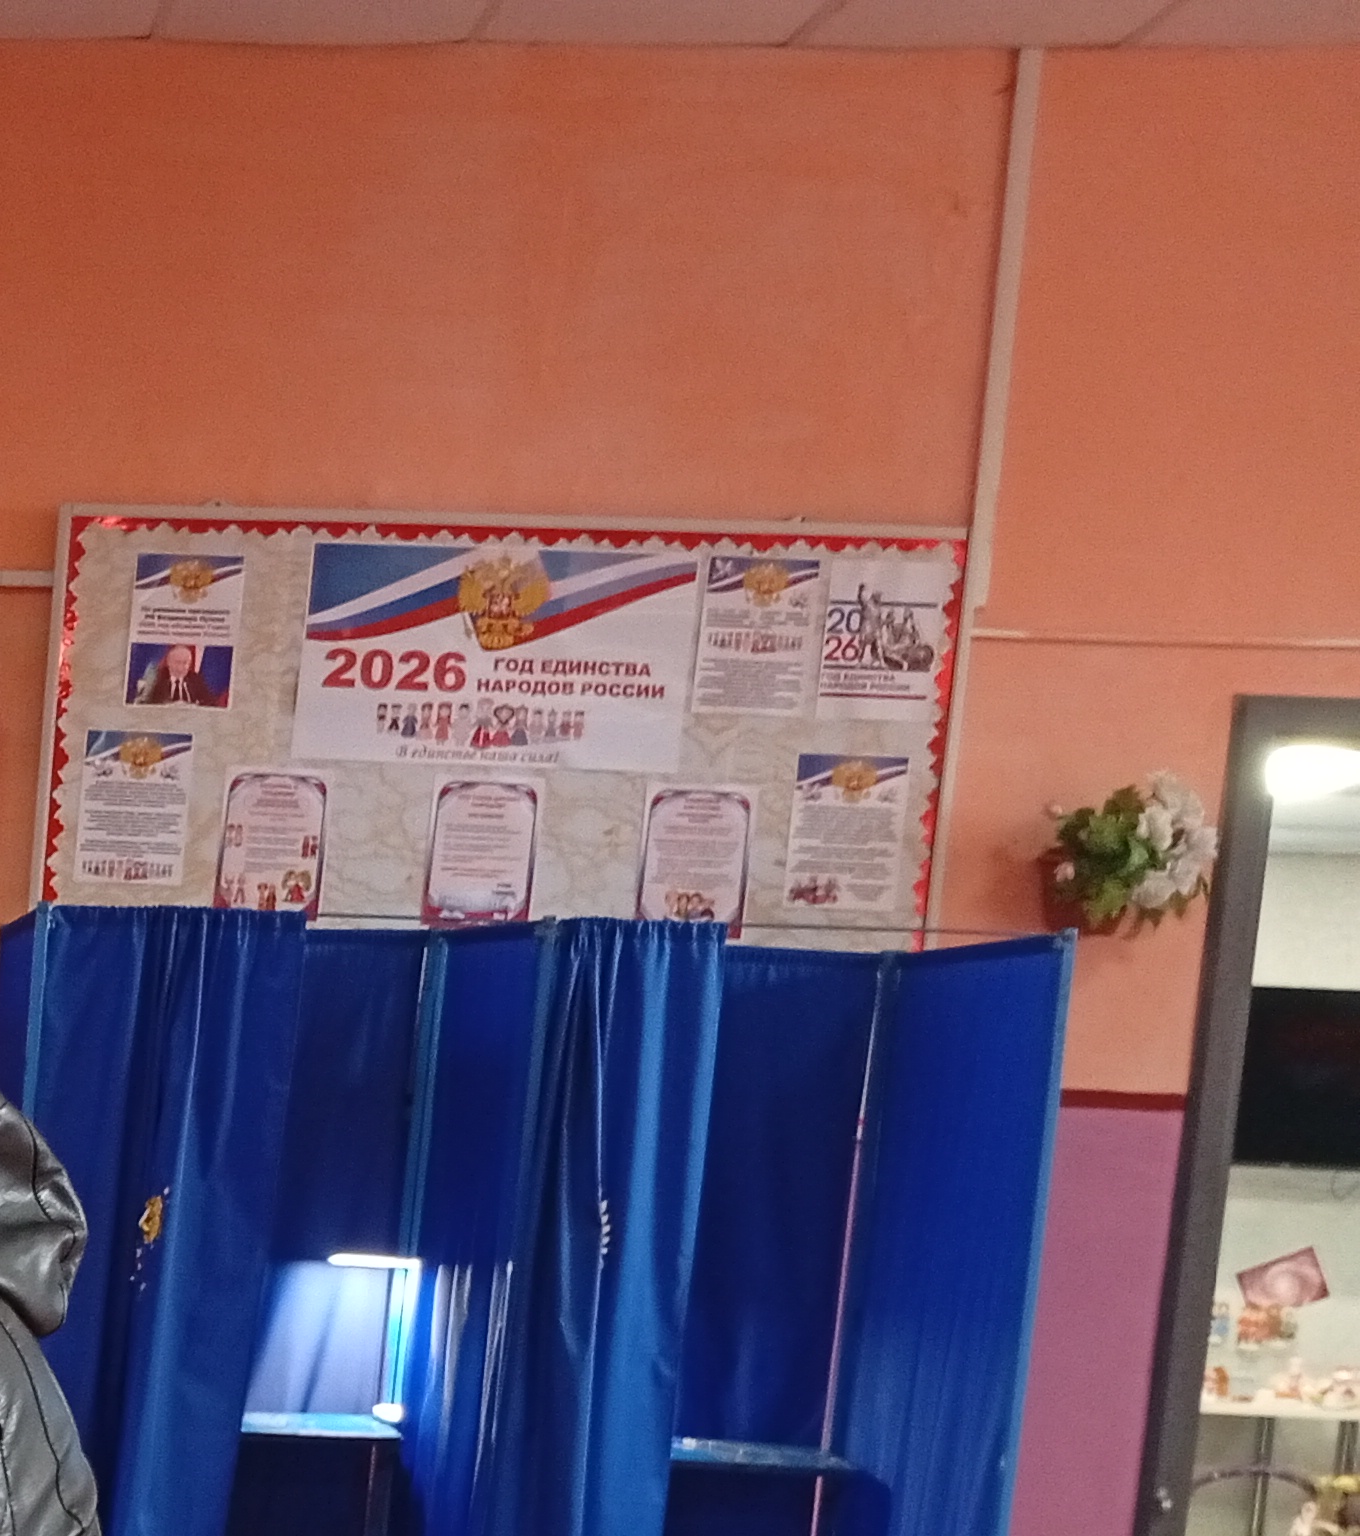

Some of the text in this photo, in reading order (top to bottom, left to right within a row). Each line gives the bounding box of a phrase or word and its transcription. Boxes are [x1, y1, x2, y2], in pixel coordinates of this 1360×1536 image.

[827, 607, 864, 635] 20
[824, 635, 859, 661] 26
[322, 648, 651, 692] 2026 ГОД ЕДИНСТВА
[477, 679, 665, 699] НАРОДОВ РОССИИ
[410, 745, 477, 760] единстве
[480, 750, 517, 762] наша
